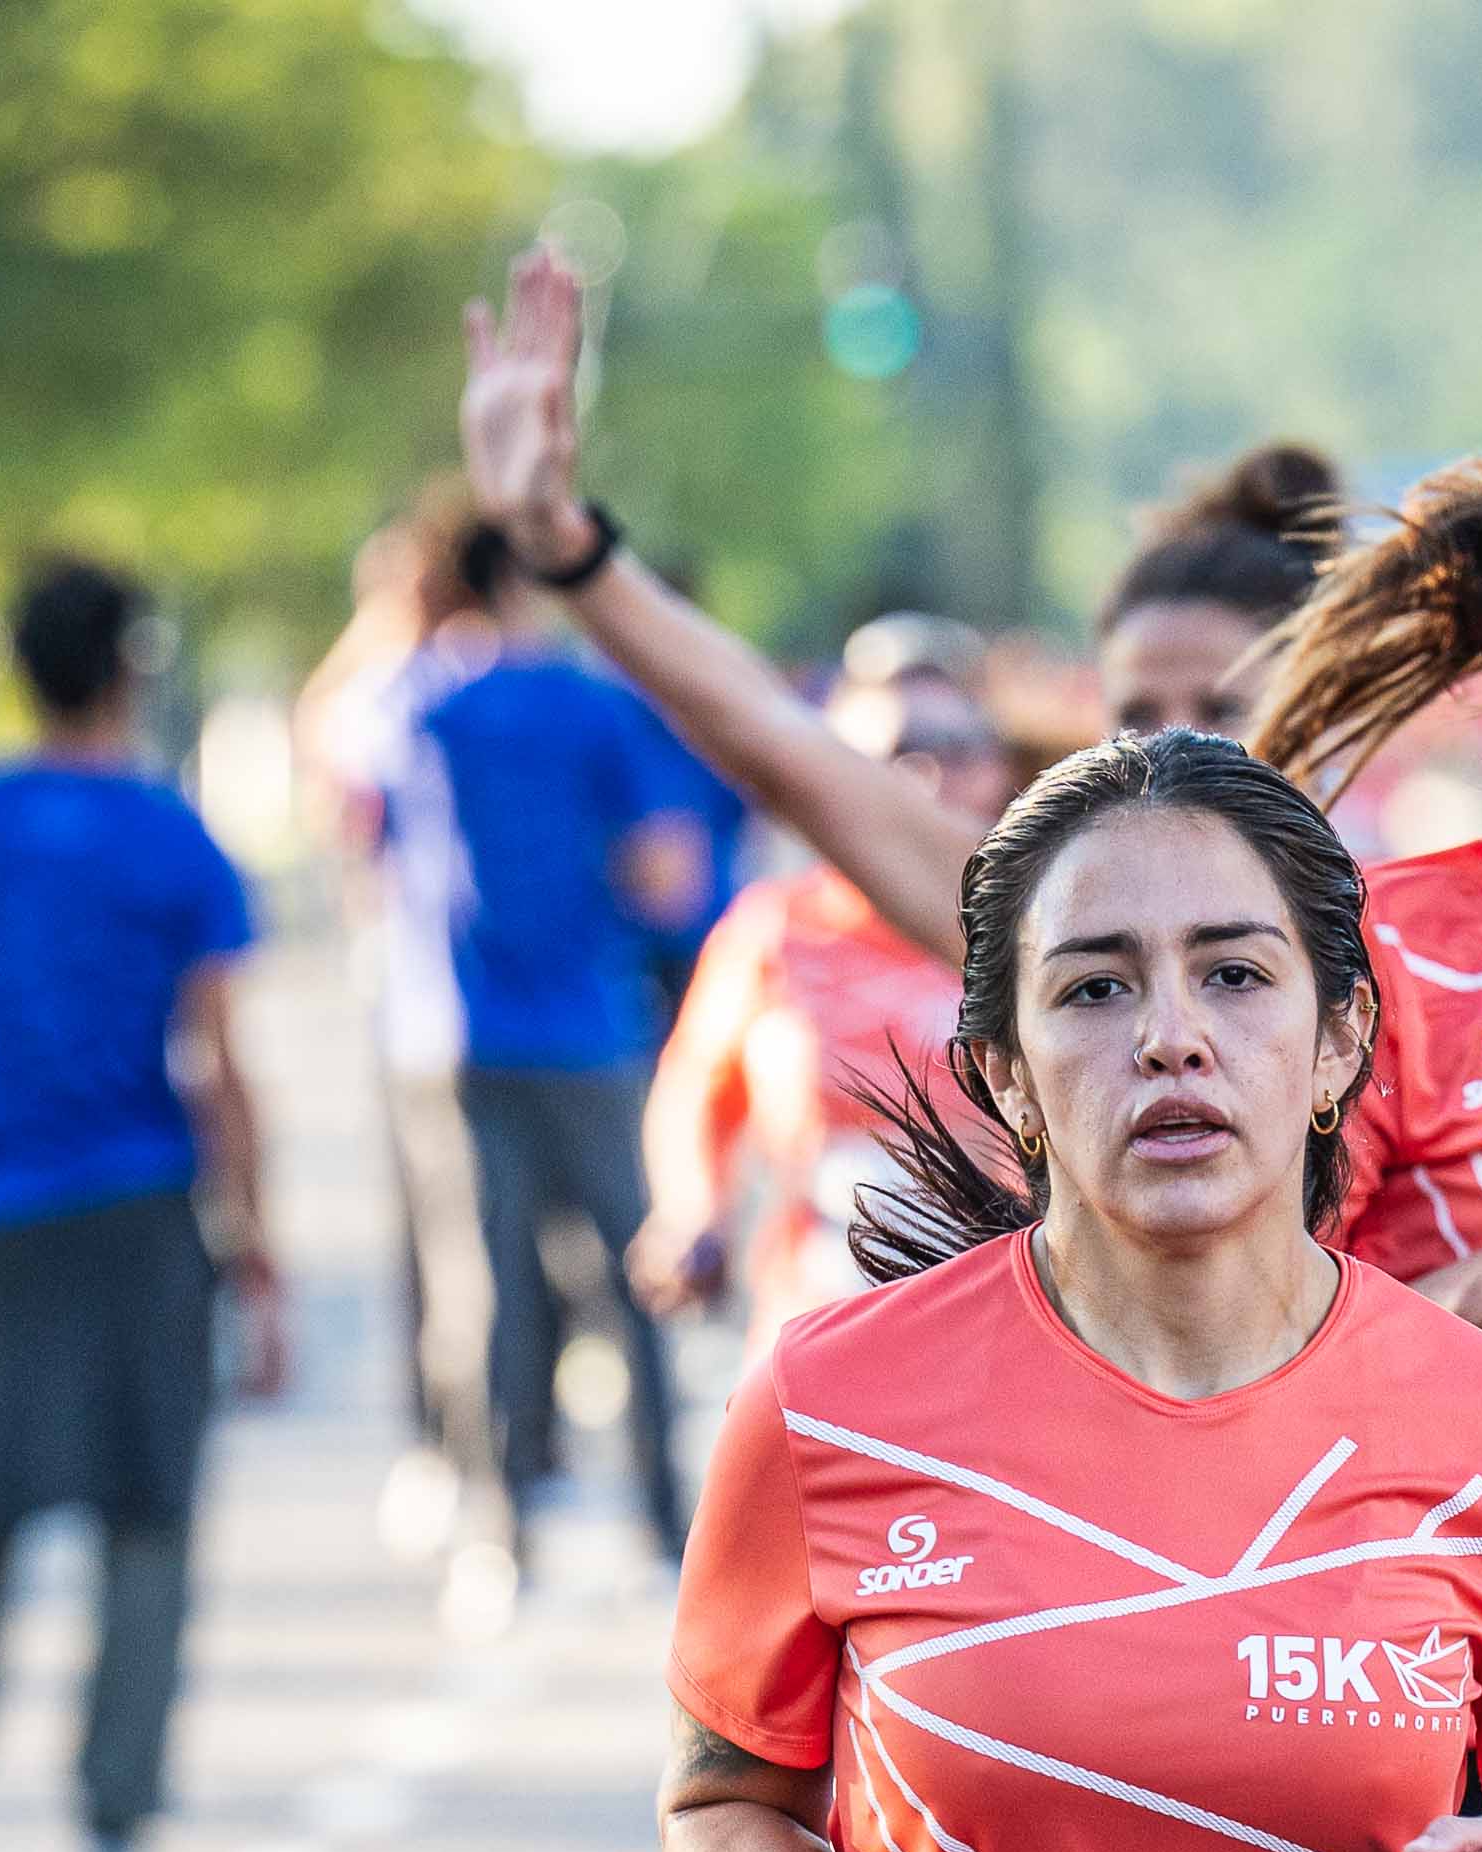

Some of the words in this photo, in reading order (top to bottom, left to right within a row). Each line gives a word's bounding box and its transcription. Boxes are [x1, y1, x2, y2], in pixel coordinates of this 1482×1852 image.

[1237, 1634, 1381, 1703] 15K
[1245, 1705, 1381, 1728] PUERTO
[1394, 1712, 1463, 1732] NORTE
